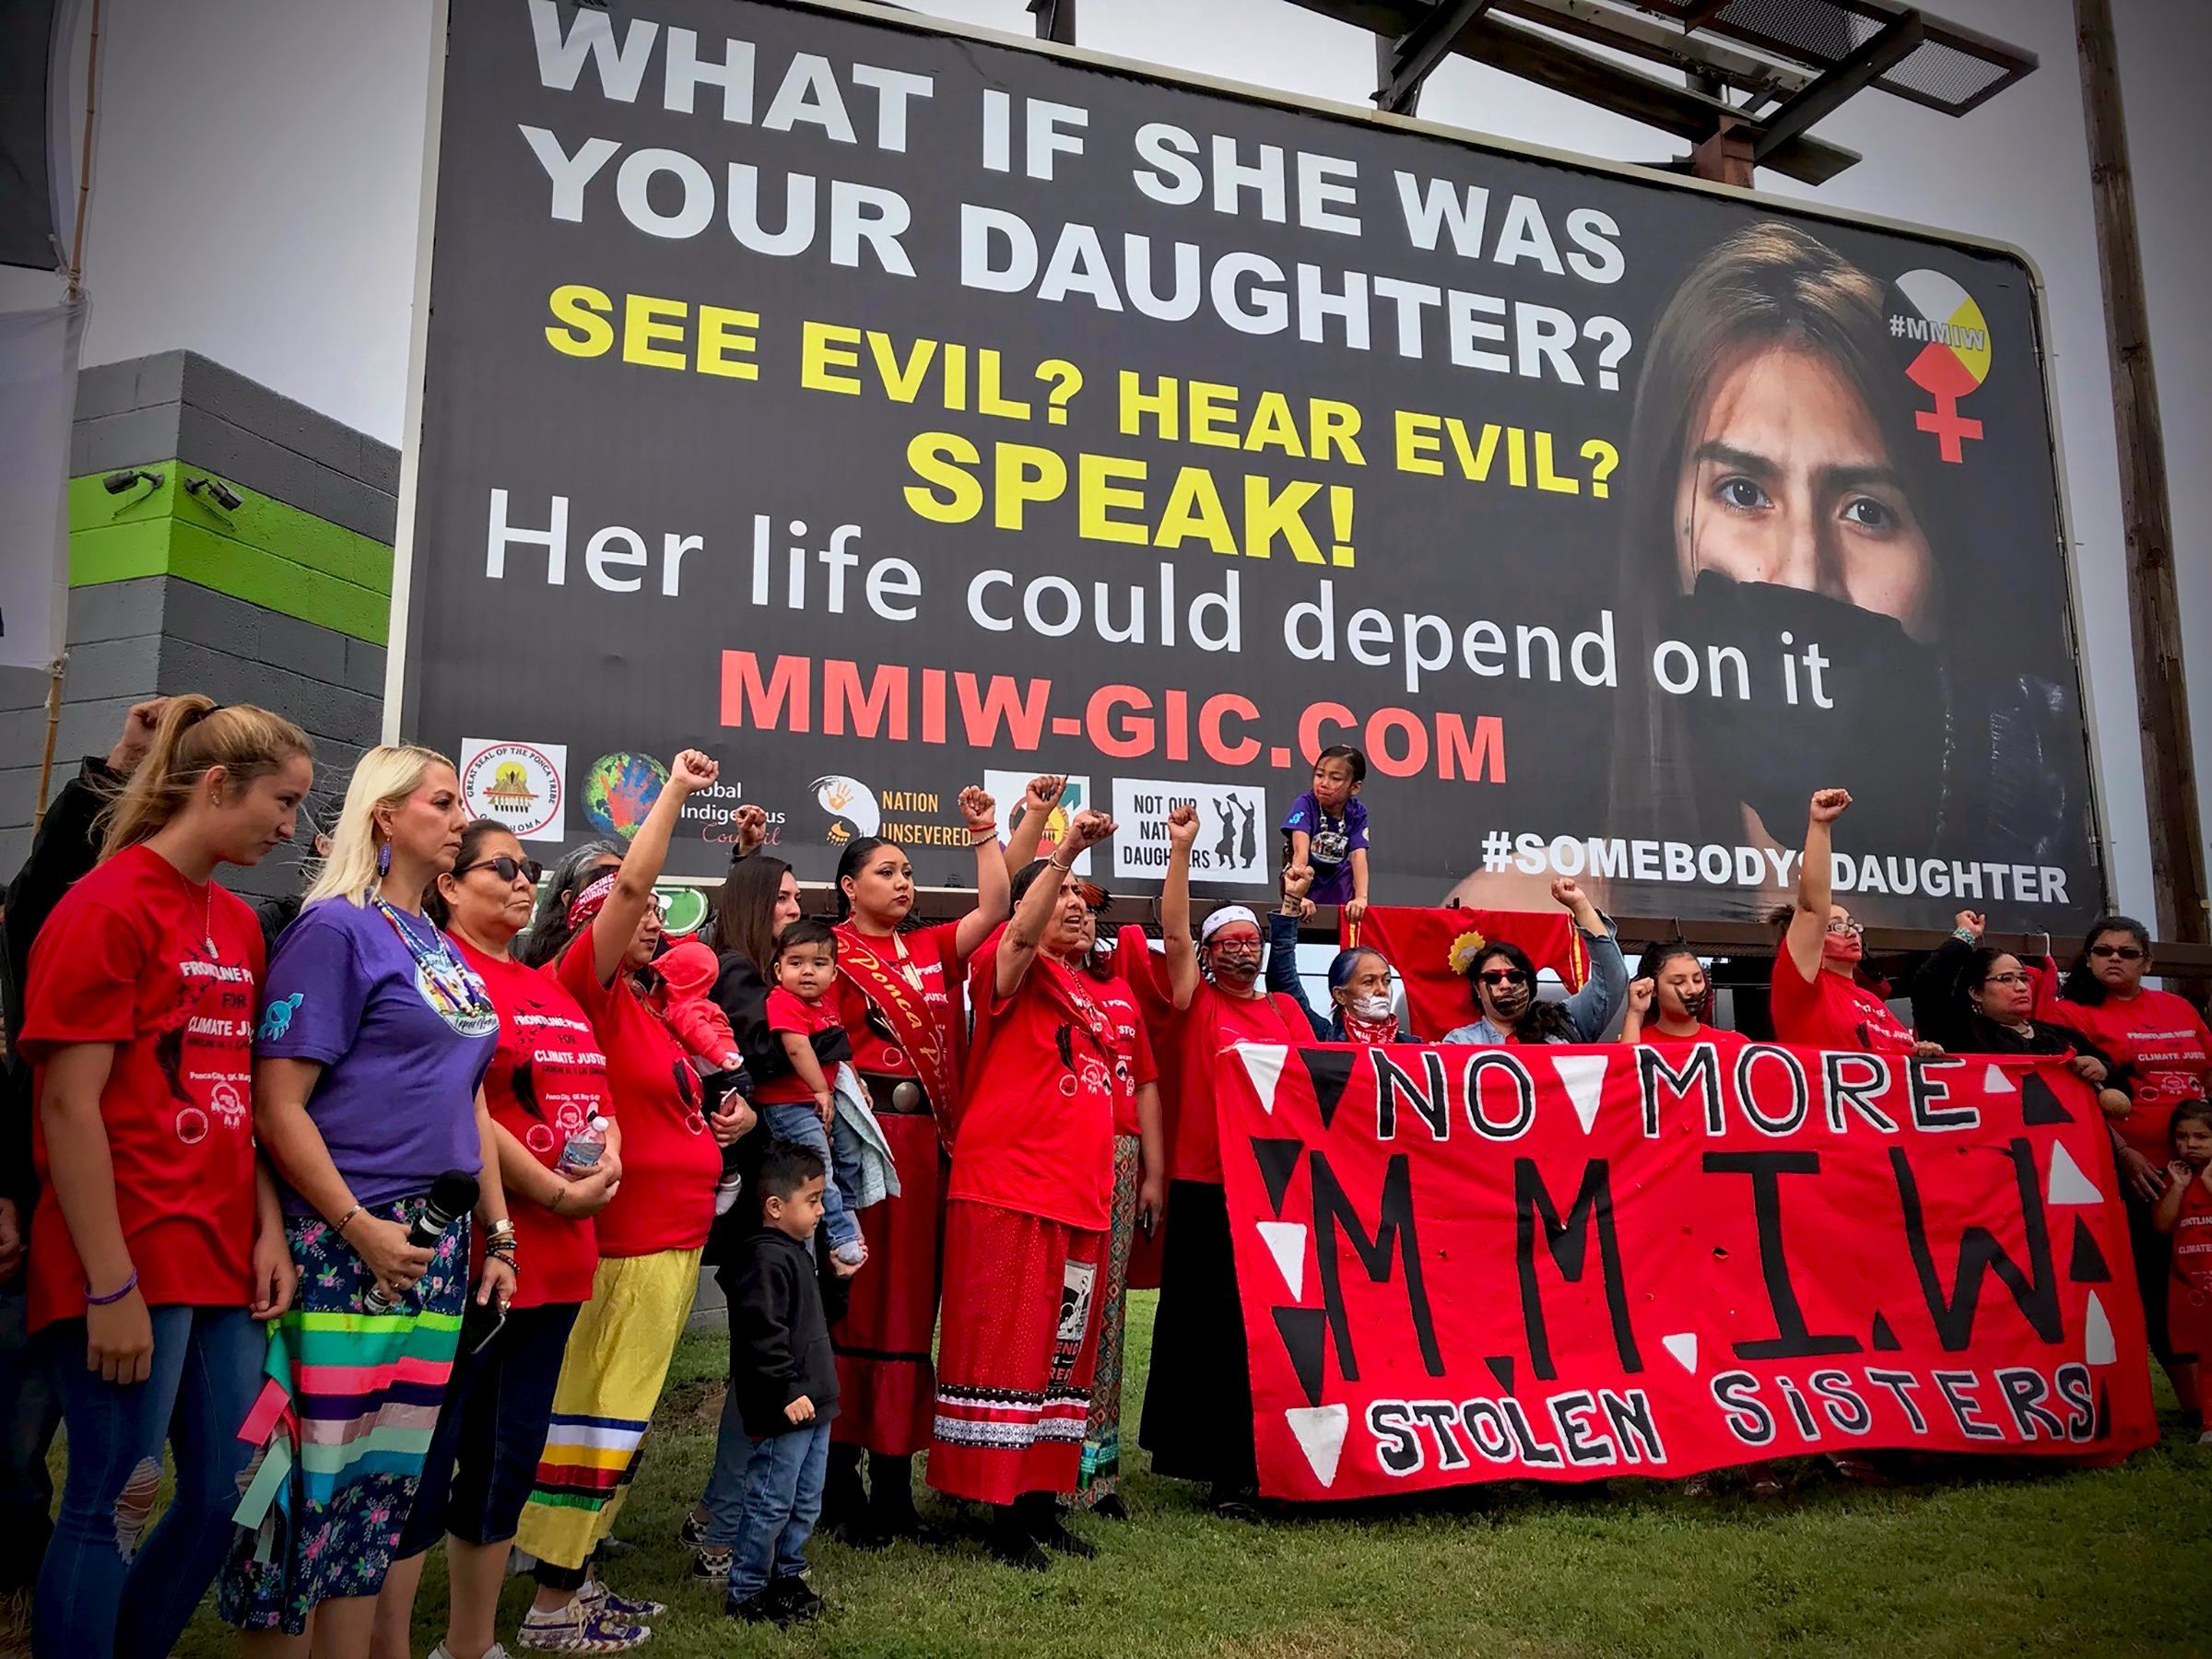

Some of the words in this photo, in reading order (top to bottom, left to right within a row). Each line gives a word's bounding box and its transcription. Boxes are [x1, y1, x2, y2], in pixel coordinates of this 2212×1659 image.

[528, 0, 934, 153] WHAT
[982, 88, 1088, 182] IF
[1133, 123, 1361, 237] SHE
[1394, 171, 1626, 284] WAS
[518, 124, 918, 277] YOUR
[960, 203, 1632, 391] DAUGHTER?
[1889, 314, 1985, 351] #MMIW
[545, 284, 759, 381] SEE
[801, 321, 1084, 425] EVIL?
[1118, 371, 1367, 465] HEAR
[1394, 410, 1620, 500] EVIL?
[903, 430, 1356, 568] SPEAK!
[486, 488, 703, 597] Her
[752, 514, 922, 621] life
[966, 562, 1241, 653] could
[1283, 580, 1618, 694] depend
[1653, 639, 1750, 701] on
[1782, 630, 1834, 710] it
[720, 649, 1507, 784] MMIW-GIC.COM
[466, 770, 477, 798] GREAT
[475, 751, 496, 769] SEAL
[496, 747, 508, 756] OF
[510, 747, 528, 757] THE
[529, 752, 552, 777] PONCA
[548, 778, 558, 805] TRIBE
[688, 781, 742, 798] obal
[681, 804, 786, 825] Indigeus
[882, 790, 938, 813] NATION
[1134, 794, 1162, 814] NOT
[479, 813, 542, 832] OHOMA
[700, 821, 782, 846] Couil
[882, 822, 972, 847] UNSEVERED
[1124, 846, 1210, 868] DAUGHRS
[847, 947, 923, 1030] Ponca
[188, 1016, 232, 1036] CLIMATE
[535, 1050, 575, 1065] CLIMATE
[2138, 1053, 2181, 1061] CLIMATE
[1369, 1045, 1535, 1141] NO
[1635, 1041, 1982, 1139] MORE
[1367, 1389, 1667, 1477] STOLEN
